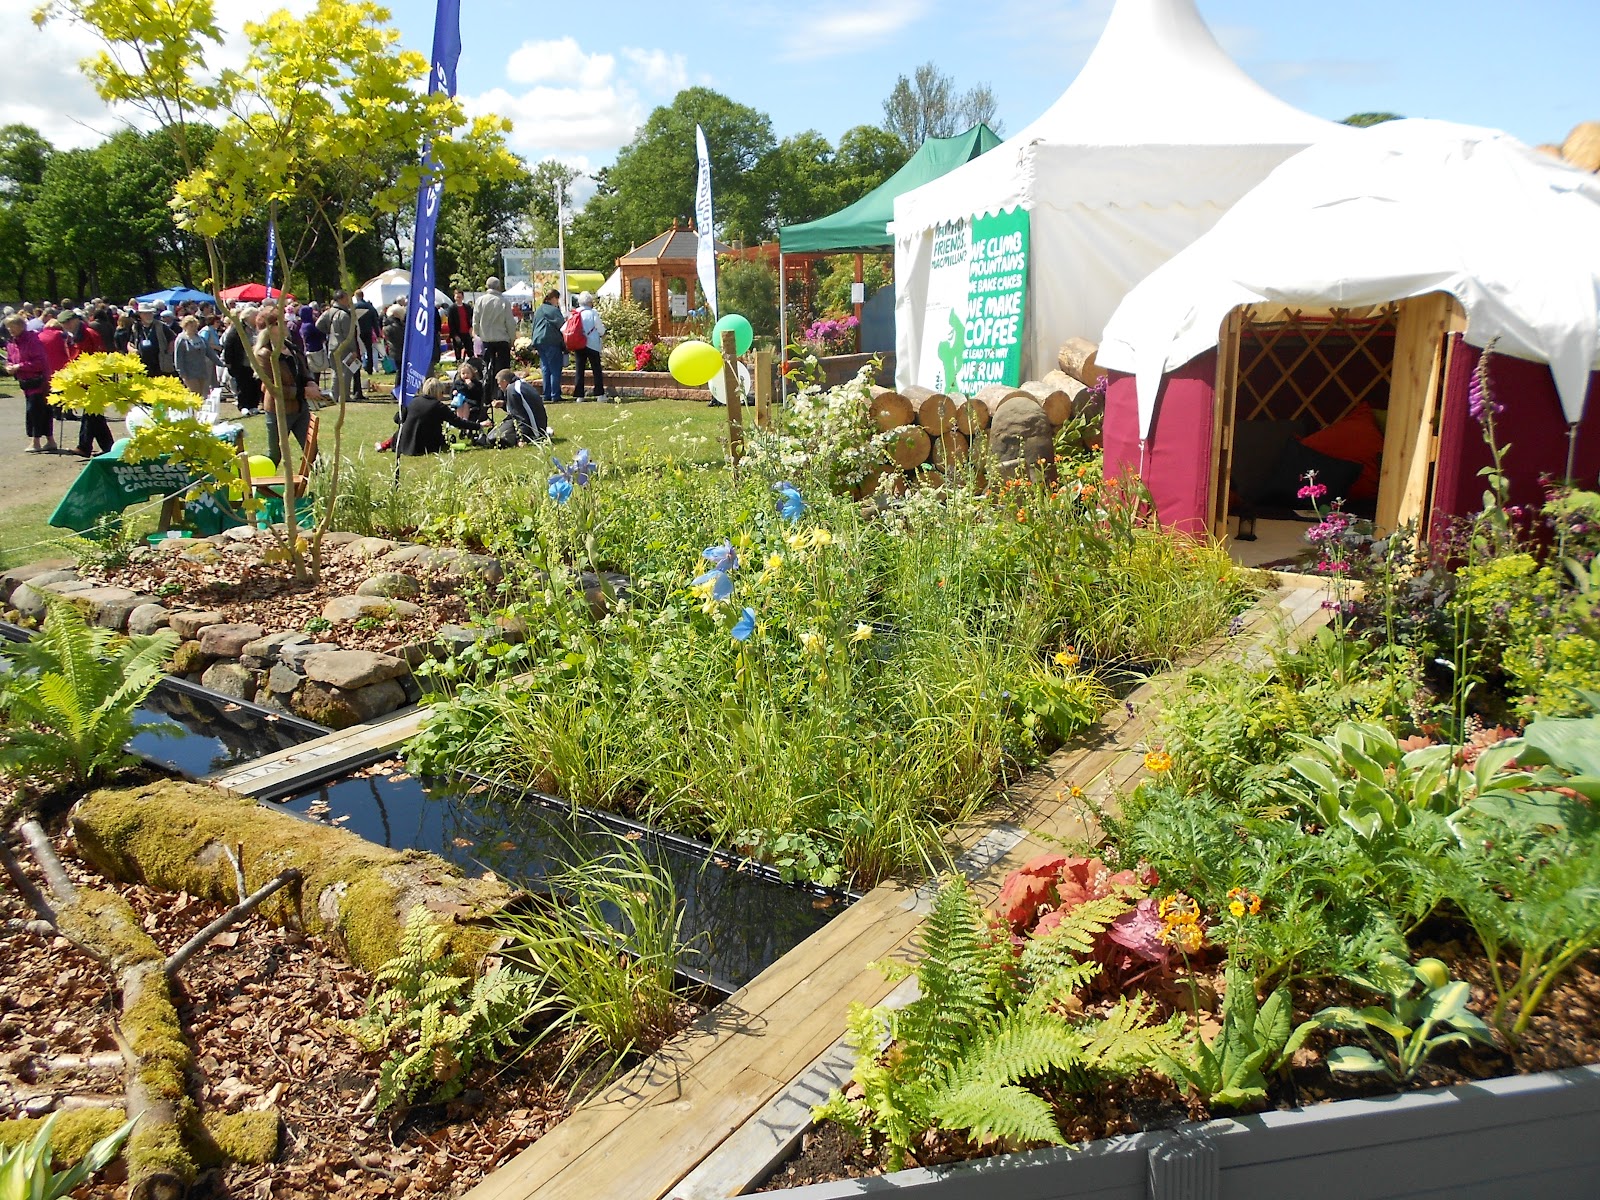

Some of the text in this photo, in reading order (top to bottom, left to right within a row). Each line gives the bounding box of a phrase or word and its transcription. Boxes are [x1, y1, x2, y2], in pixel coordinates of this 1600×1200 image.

[971, 231, 1022, 261] WE CLIMB
[970, 252, 1025, 277] MOUNTAINS
[978, 277, 997, 293] BAKE
[997, 273, 1022, 291] CAKES
[968, 296, 983, 318] WE
[985, 291, 1022, 318] MAKE
[964, 315, 1019, 348] COFFEE
[969, 348, 983, 359] LEAD
[995, 347, 1008, 359] WAY
[961, 360, 1005, 381] WE RUN
[113, 462, 190, 474] WE ARE
[124, 480, 177, 493] CANCER
